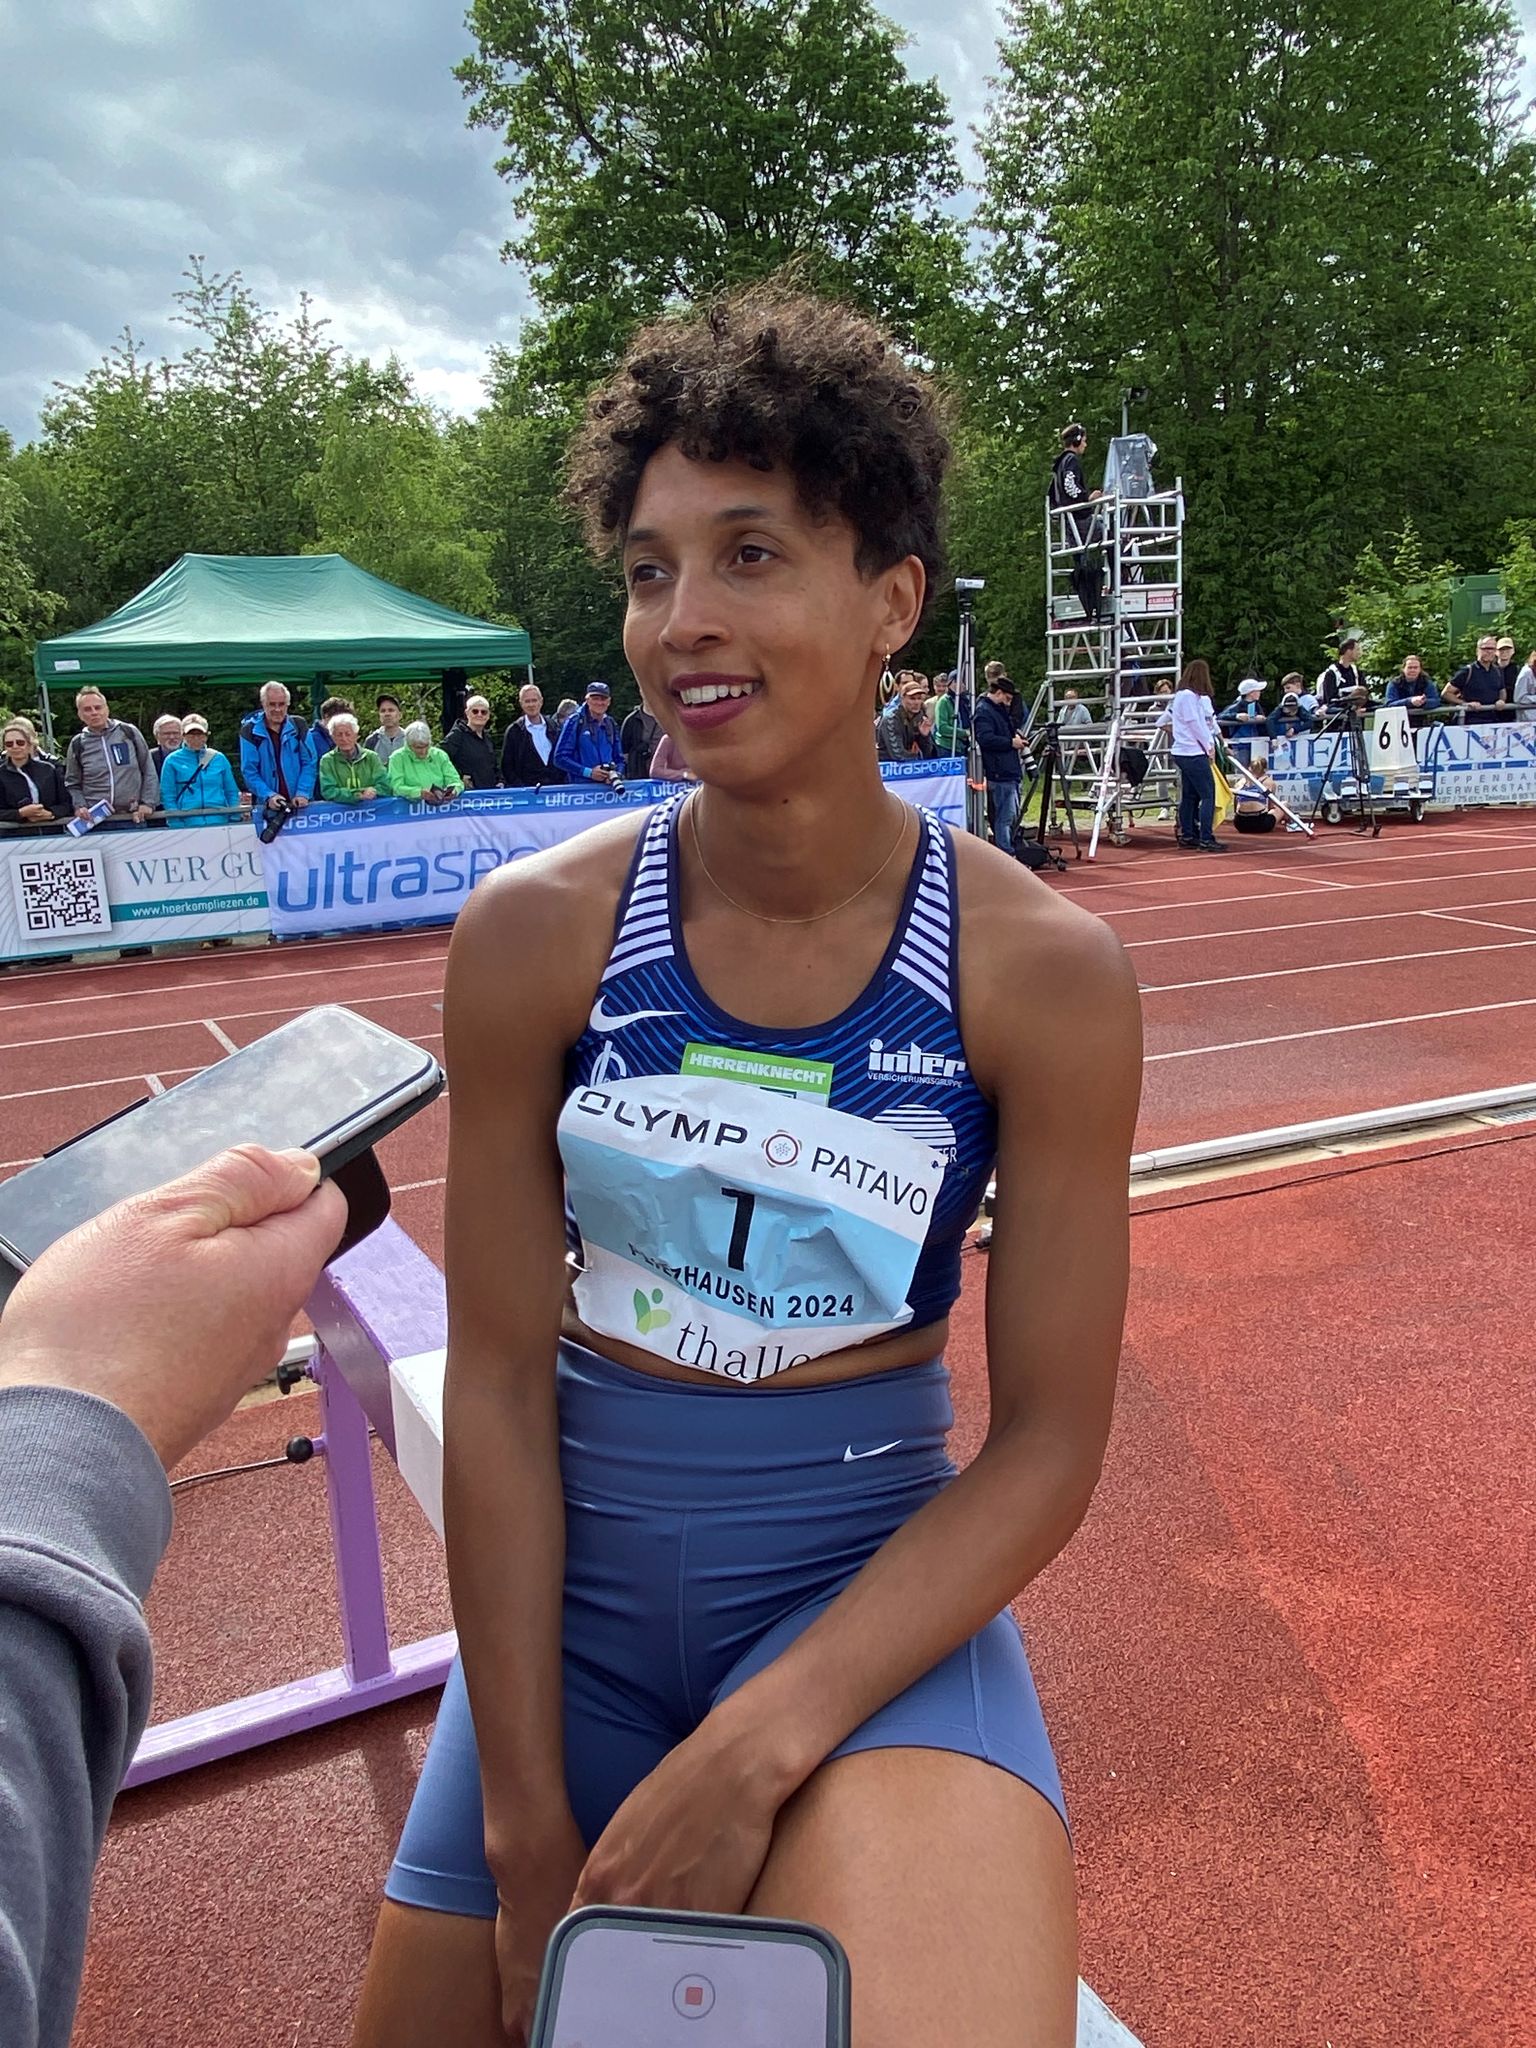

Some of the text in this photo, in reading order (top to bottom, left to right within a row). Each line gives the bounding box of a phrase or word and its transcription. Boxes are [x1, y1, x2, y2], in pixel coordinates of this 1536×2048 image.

[1378, 721, 1391, 750] 6
[1400, 719, 1409, 748] 6
[544, 788, 644, 808] ultraSPORTS
[125, 855, 210, 886] WER
[132, 896, 259, 917] www.hoerkompliezen.de
[689, 1052, 827, 1085] HERRENKNECHT
[868, 1038, 966, 1078] inter
[867, 1072, 964, 1089] VERSICHERUNGSGRUPPE
[577, 1090, 928, 1216] OLYMP PATAVO
[787, 1294, 854, 1319] 2024
